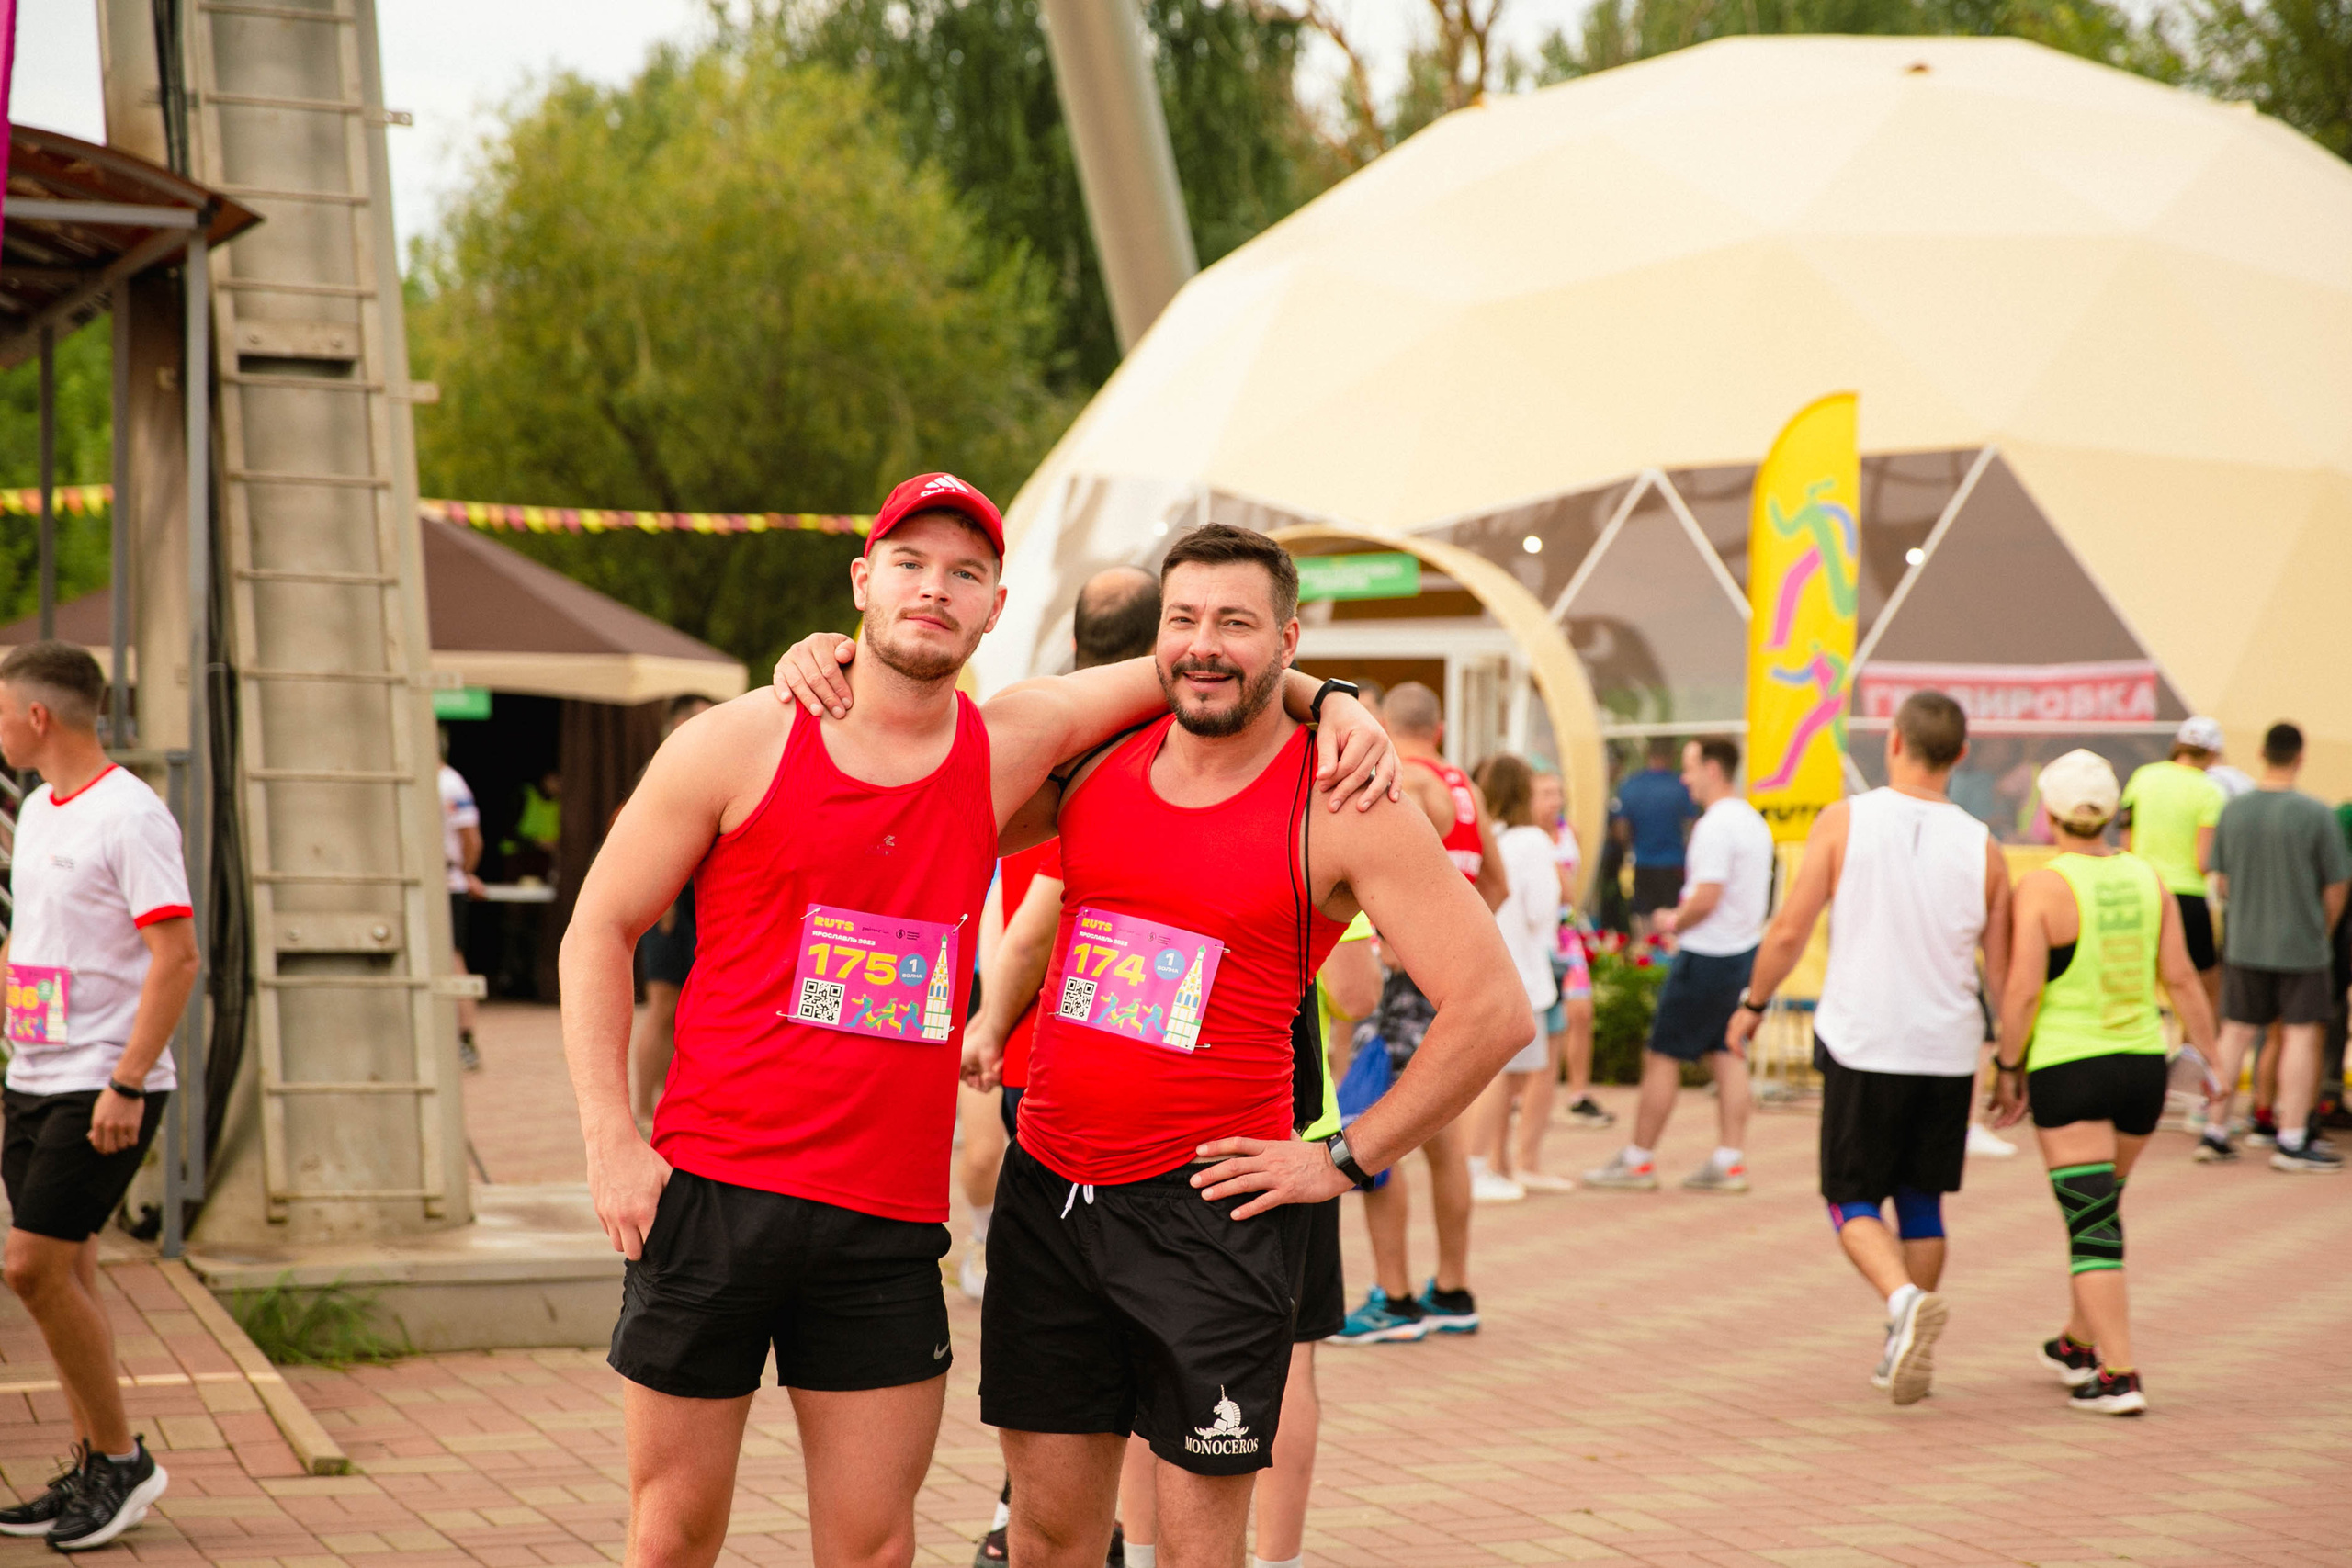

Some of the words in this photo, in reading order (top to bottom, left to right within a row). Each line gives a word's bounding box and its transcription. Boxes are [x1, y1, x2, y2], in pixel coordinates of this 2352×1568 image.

[814, 916, 854, 931] RUTS
[1081, 918, 1113, 932] RUTS
[812, 930, 857, 943] ЯРОСЛАВЛЬ
[1079, 931, 1114, 943] ЯРОСЛАВЛЬ
[808, 942, 898, 986] 175
[909, 958, 918, 973] 1
[1073, 942, 1147, 987] 174
[1165, 953, 1175, 966] 1
[1184, 1435, 1259, 1455] MONOCEROS
